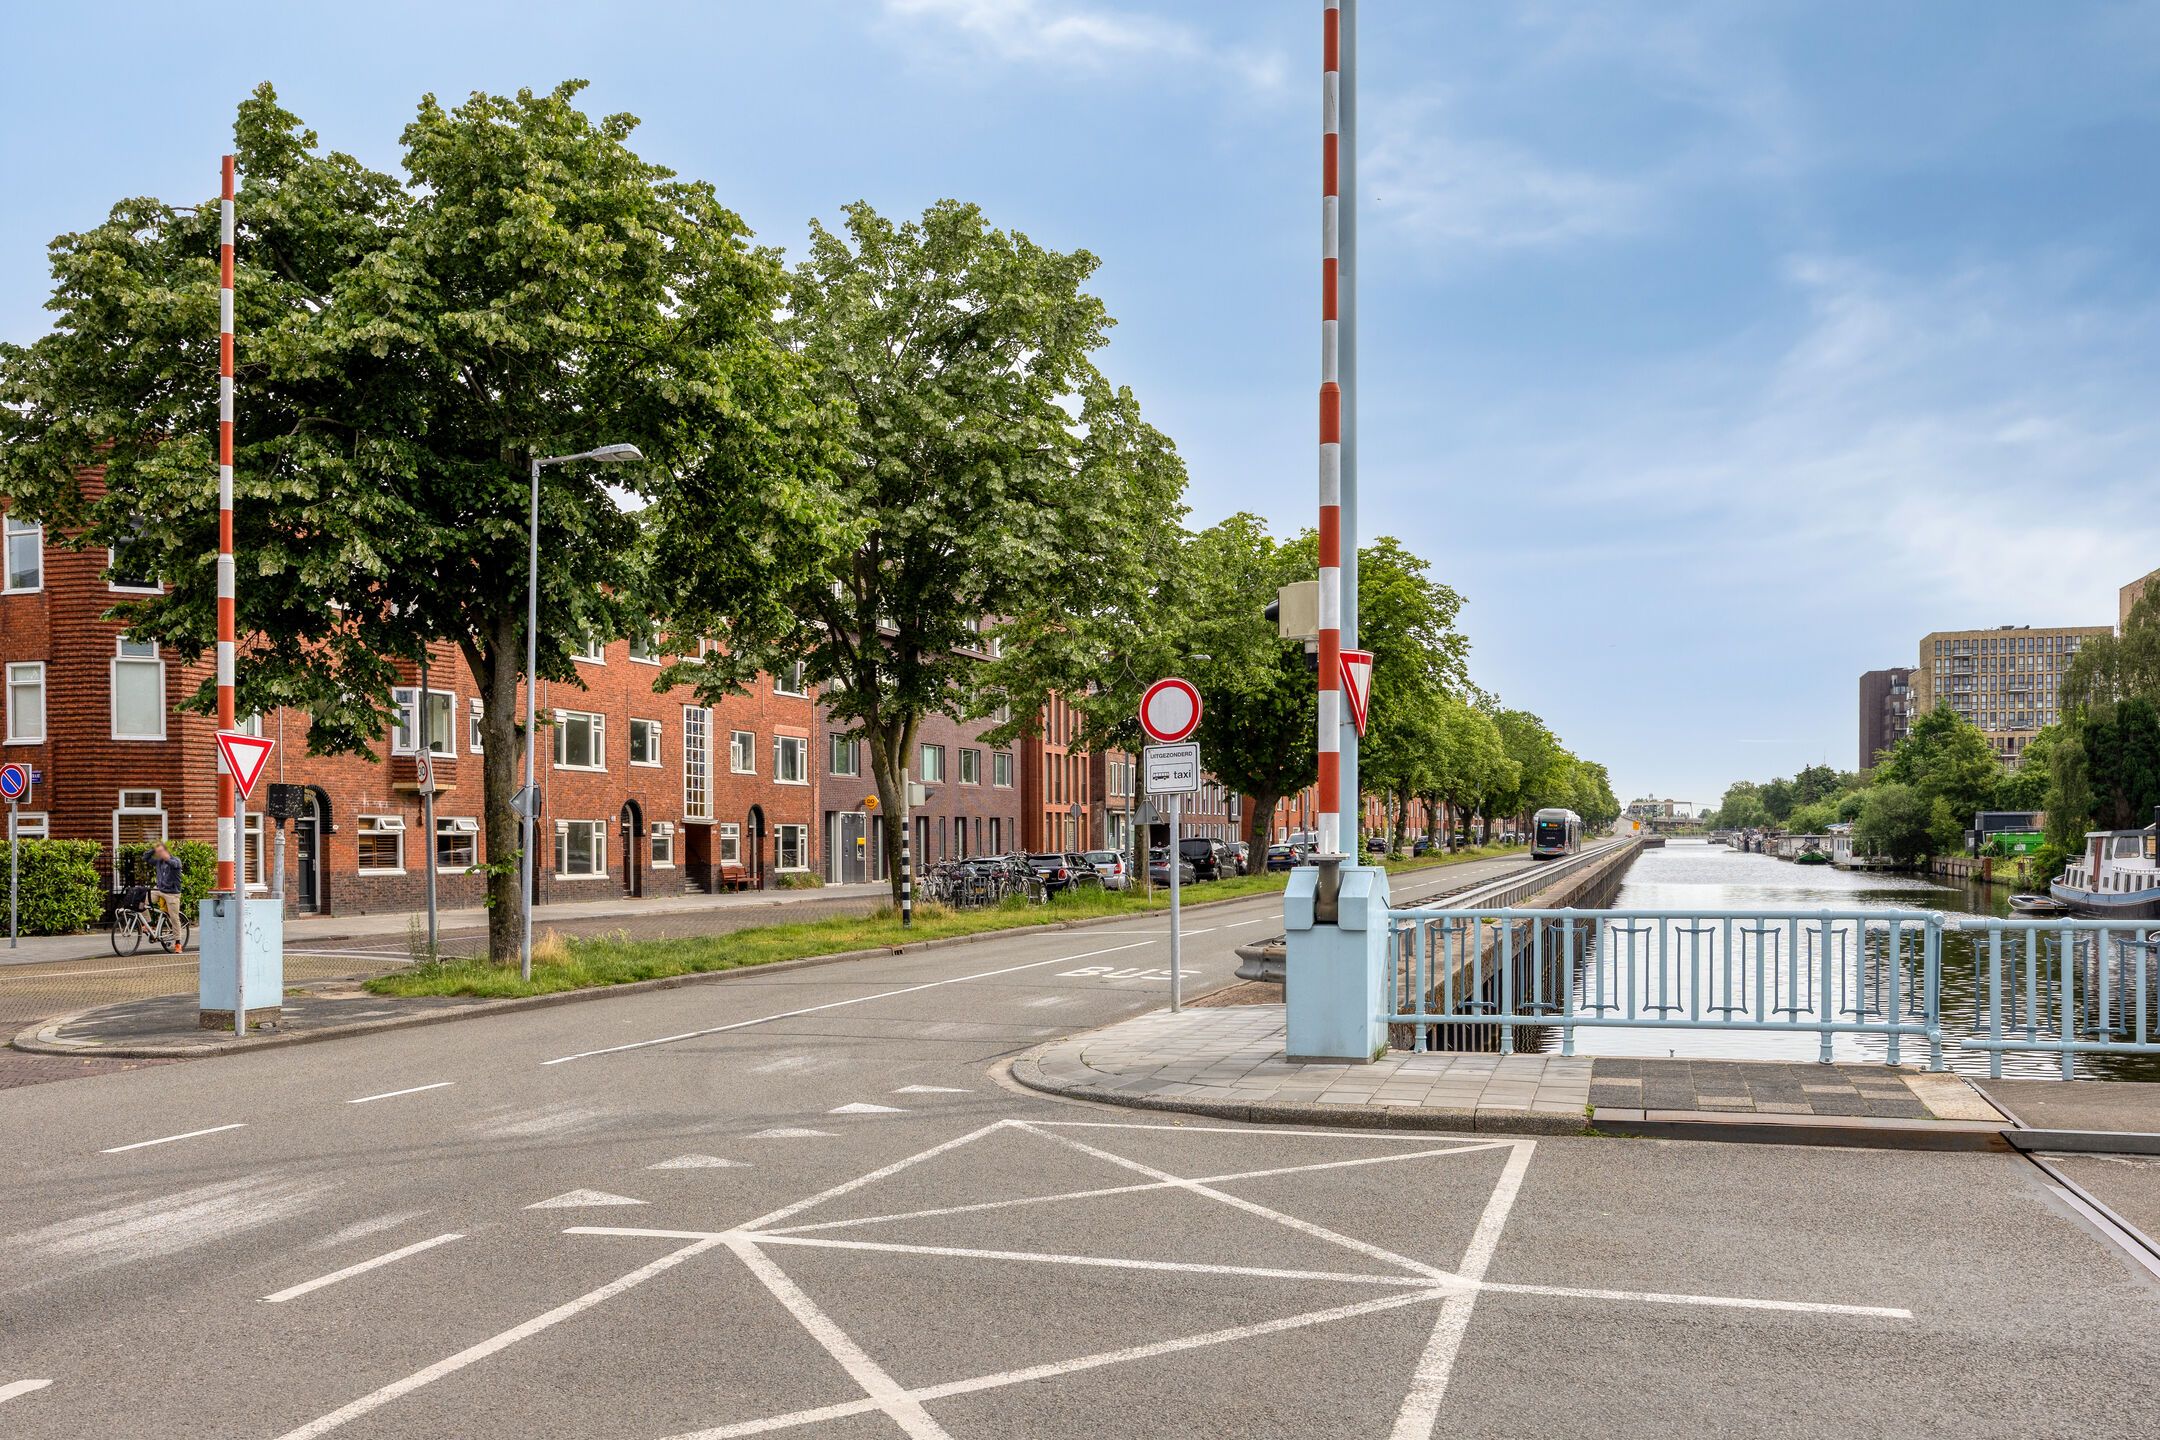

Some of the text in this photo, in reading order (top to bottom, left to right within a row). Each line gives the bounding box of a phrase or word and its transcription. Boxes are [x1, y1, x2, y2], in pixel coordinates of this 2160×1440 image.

[1150, 751, 1193, 759] UITGEZONDERD
[1173, 769, 1191, 779] taxi
[1055, 966, 1203, 980] BUS
